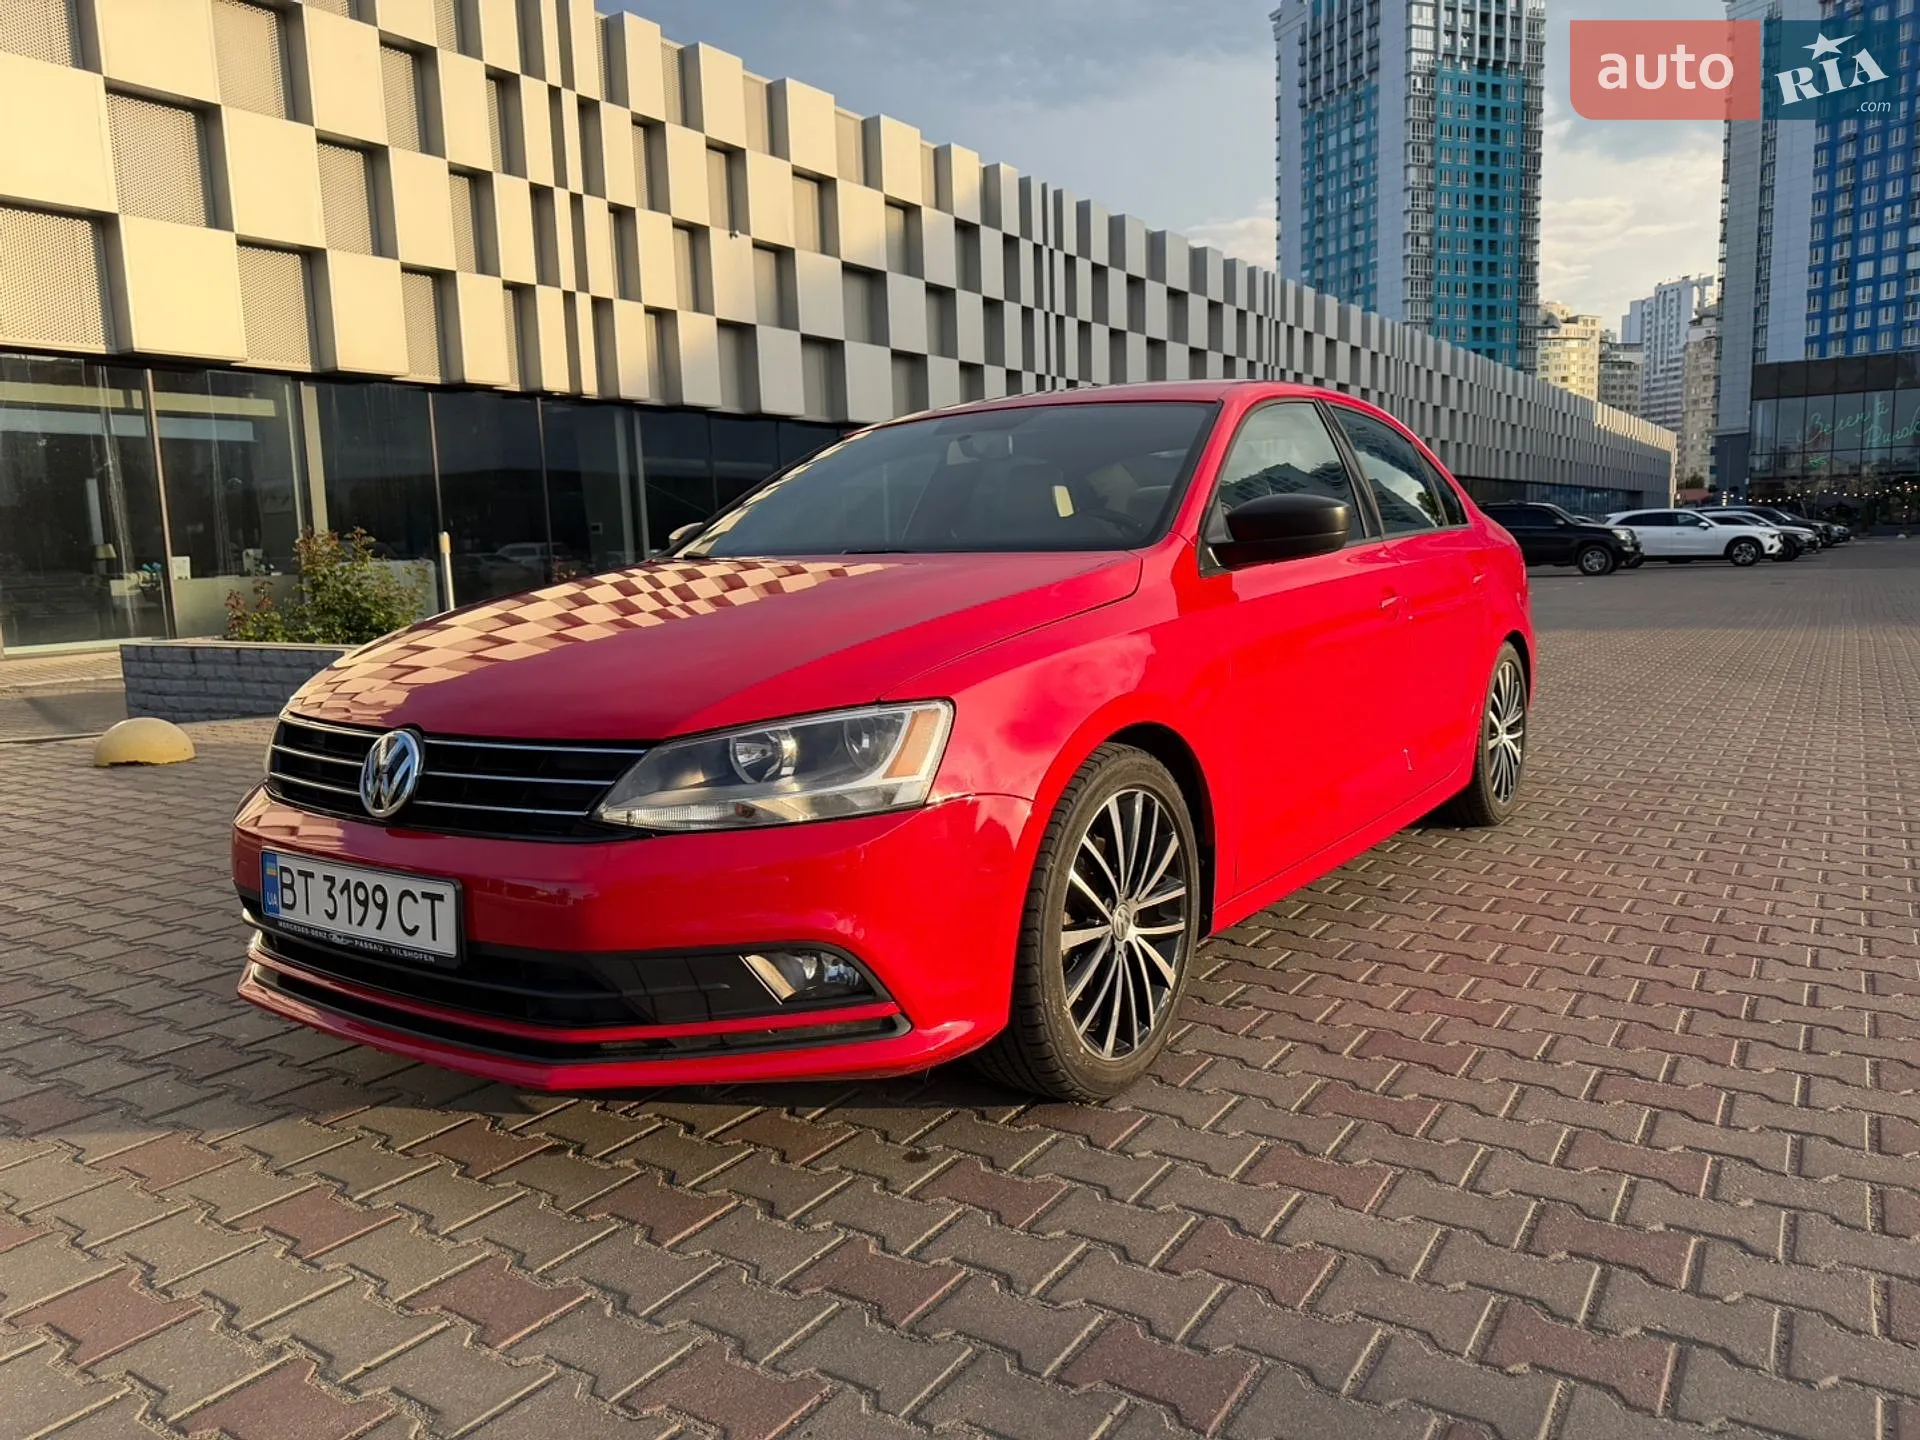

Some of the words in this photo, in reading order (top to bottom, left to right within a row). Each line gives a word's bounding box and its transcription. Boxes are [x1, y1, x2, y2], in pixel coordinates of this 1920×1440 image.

[266, 890, 278, 906] UA
[279, 865, 315, 916] BT
[322, 874, 388, 931] 3199
[397, 888, 445, 942] CT
